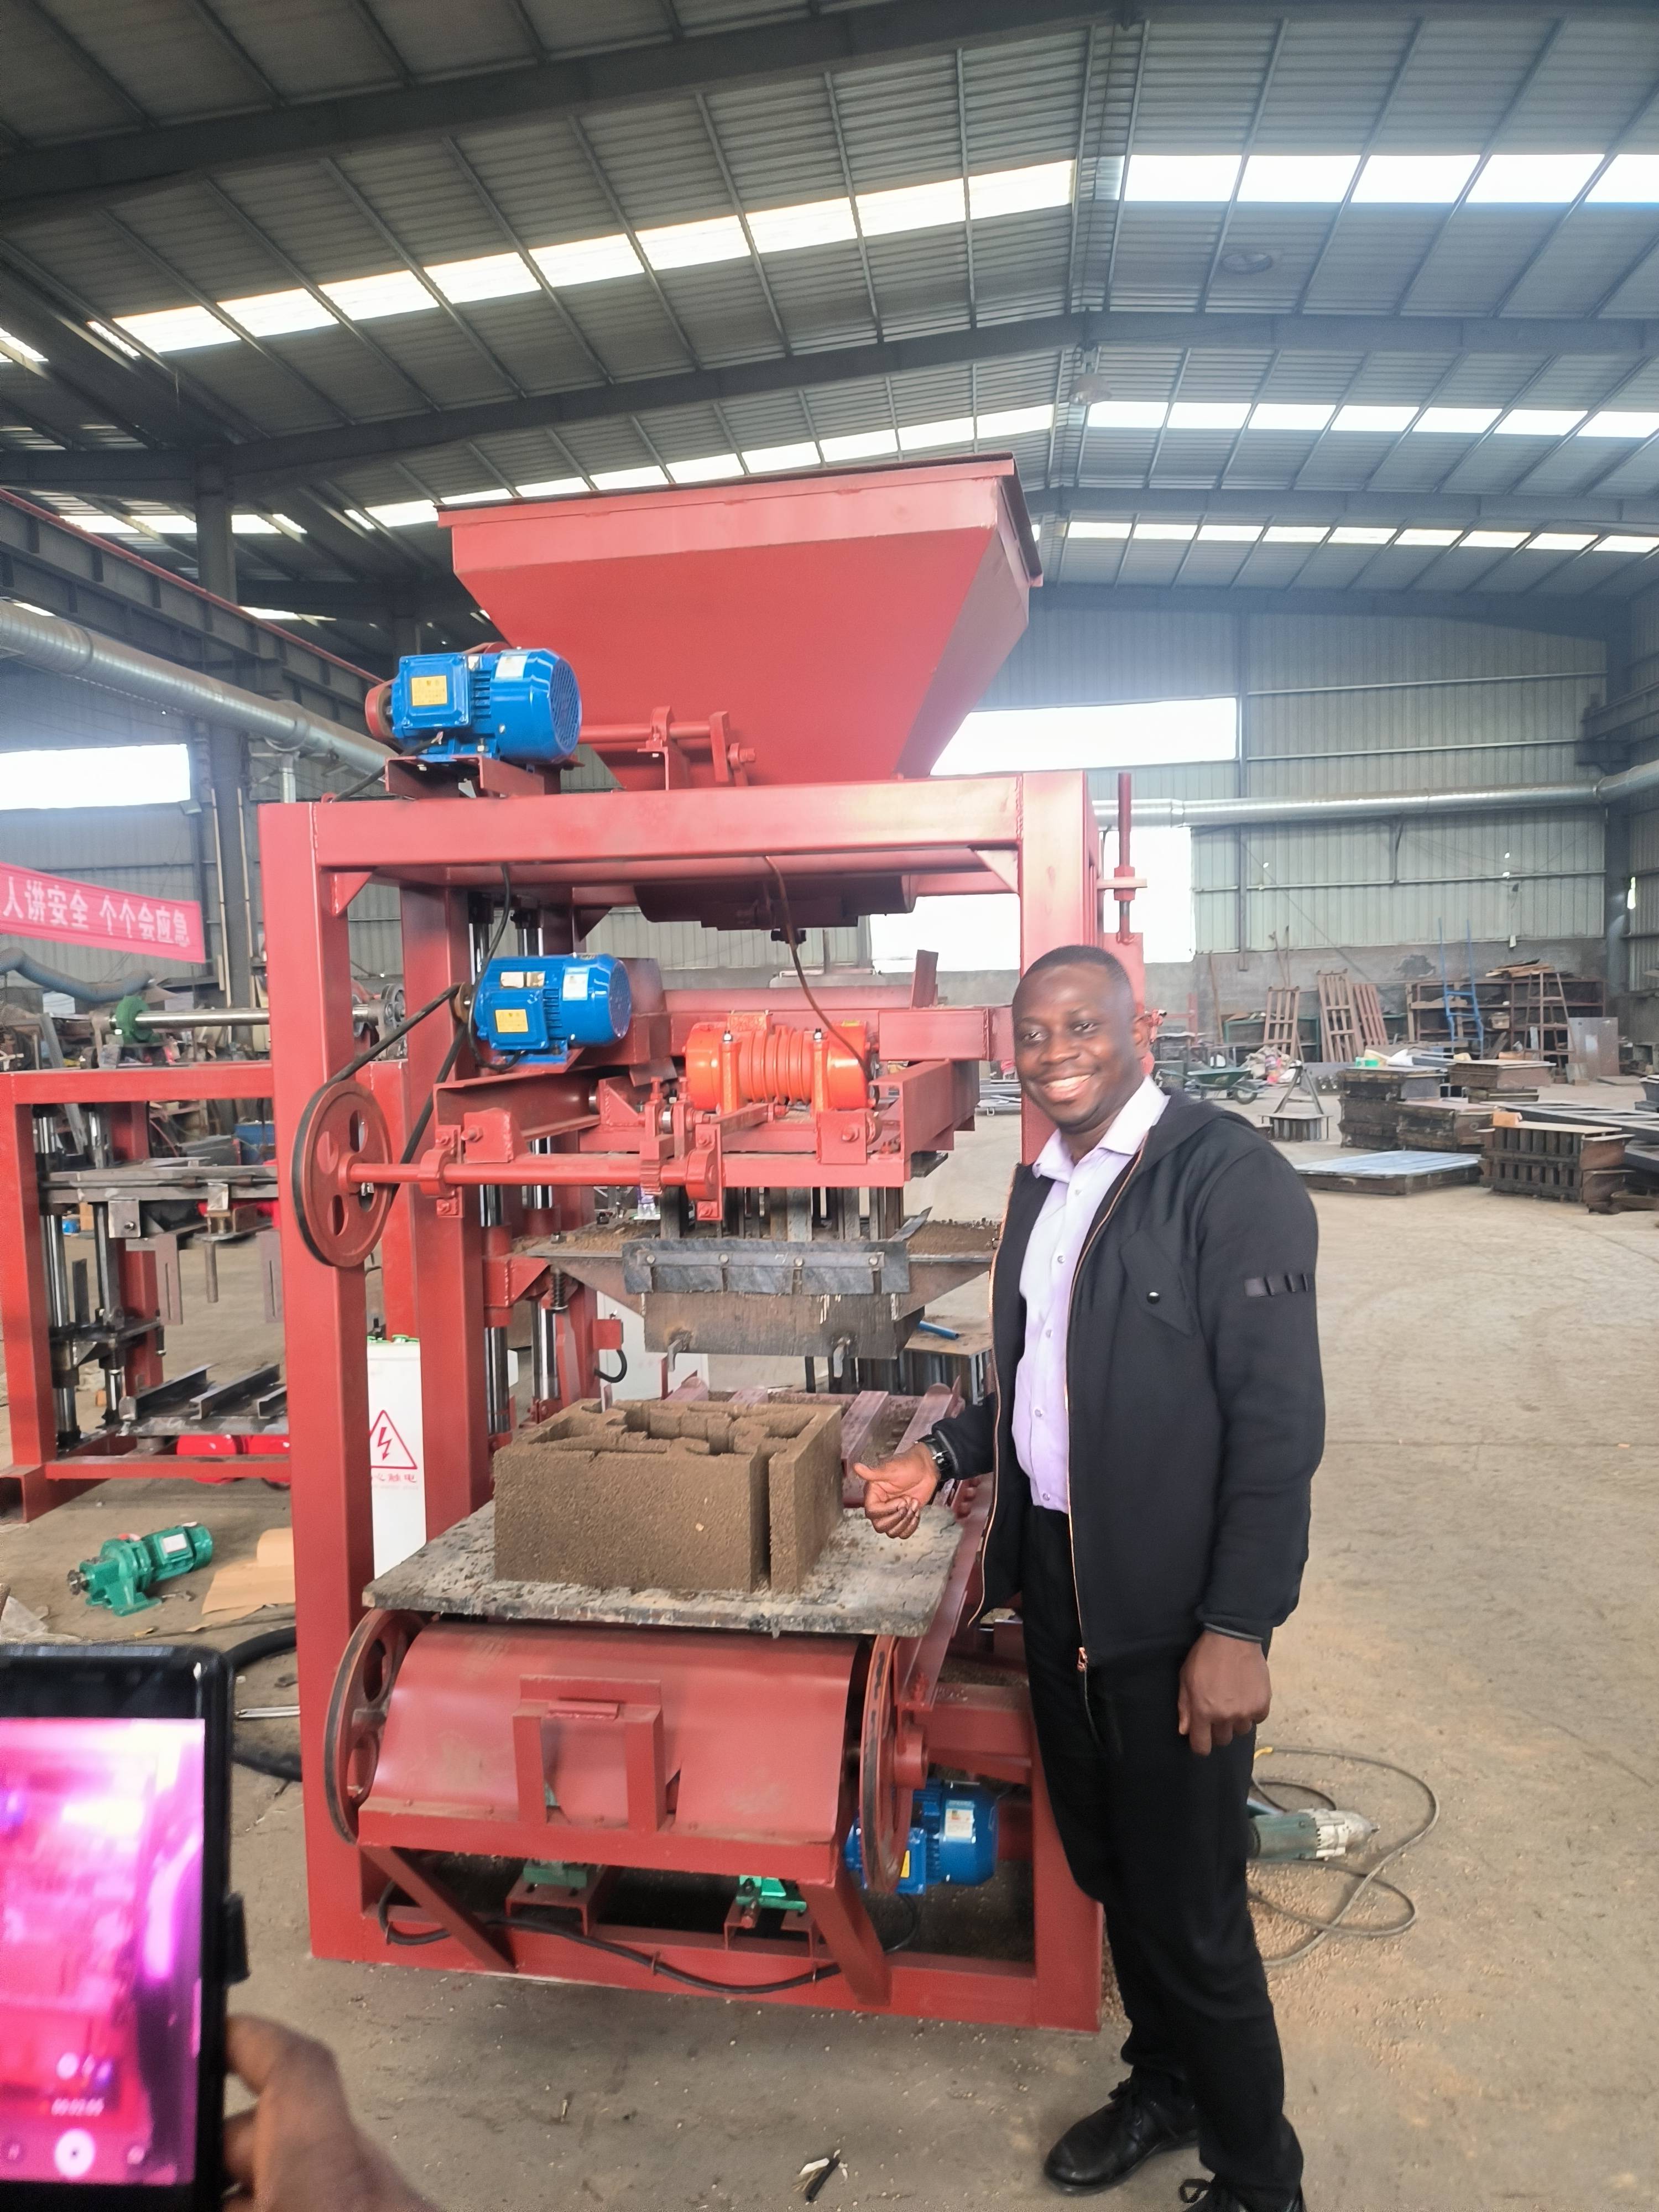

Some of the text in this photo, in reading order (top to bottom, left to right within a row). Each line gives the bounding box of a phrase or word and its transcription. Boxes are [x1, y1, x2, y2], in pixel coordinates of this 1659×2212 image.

[100, 895, 190, 947] 个个会应急
